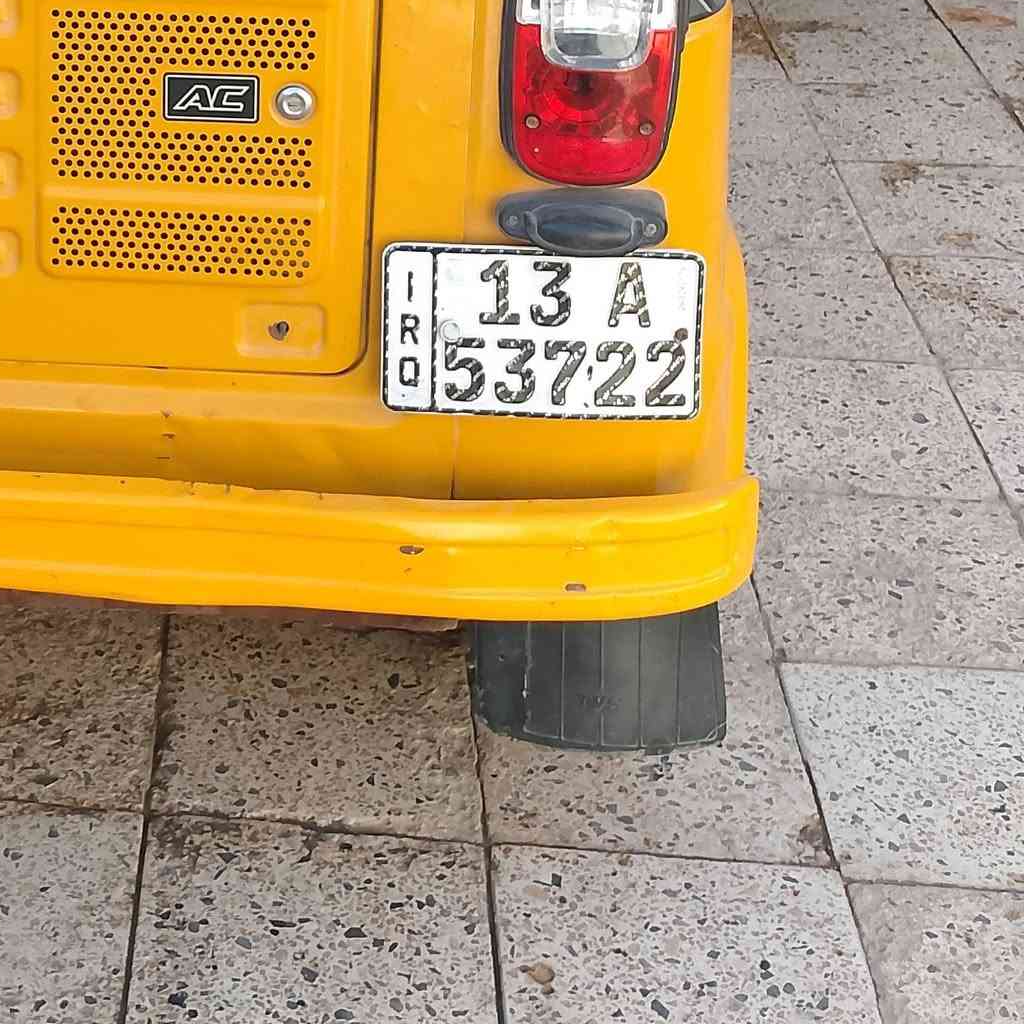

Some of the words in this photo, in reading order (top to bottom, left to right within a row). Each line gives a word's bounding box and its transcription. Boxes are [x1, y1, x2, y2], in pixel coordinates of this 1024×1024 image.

[173, 85, 250, 112] AC
[479, 260, 572, 327] 13
[608, 262, 651, 327] A
[444, 337, 687, 407] 53722
